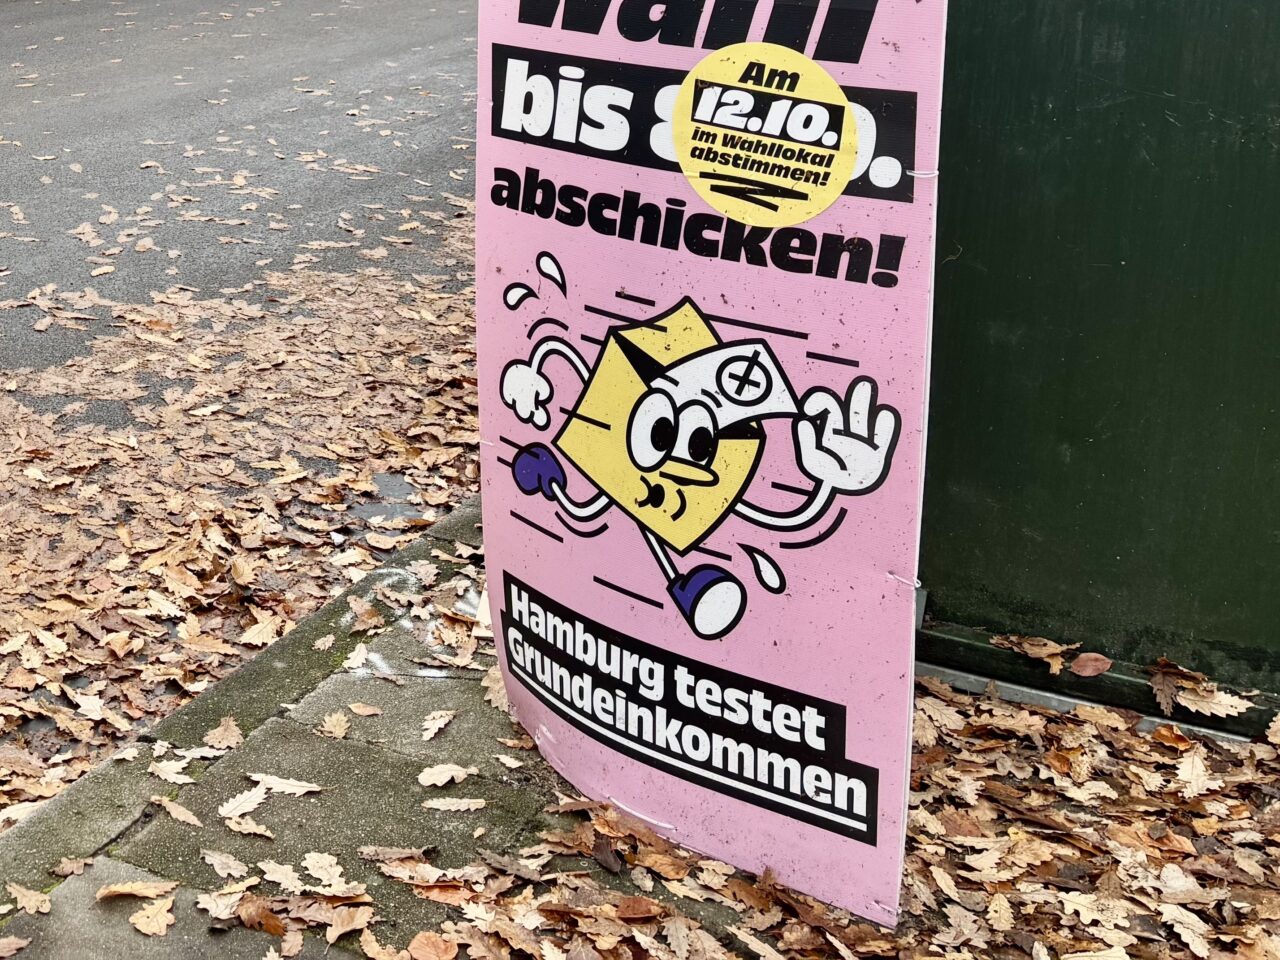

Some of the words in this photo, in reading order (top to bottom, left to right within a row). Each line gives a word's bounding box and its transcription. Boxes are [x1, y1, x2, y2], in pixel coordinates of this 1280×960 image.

[500, 58, 634, 152] bis
[737, 61, 801, 93] Am
[691, 126, 718, 145] im
[721, 133, 835, 169] Wahllokal
[693, 86, 839, 147] 12.10.
[689, 146, 832, 187] abstimmen!
[490, 167, 906, 289] abschicken!
[510, 583, 665, 702] Hamburg
[674, 664, 826, 751] testet
[507, 626, 868, 817] Grundeinkommen
